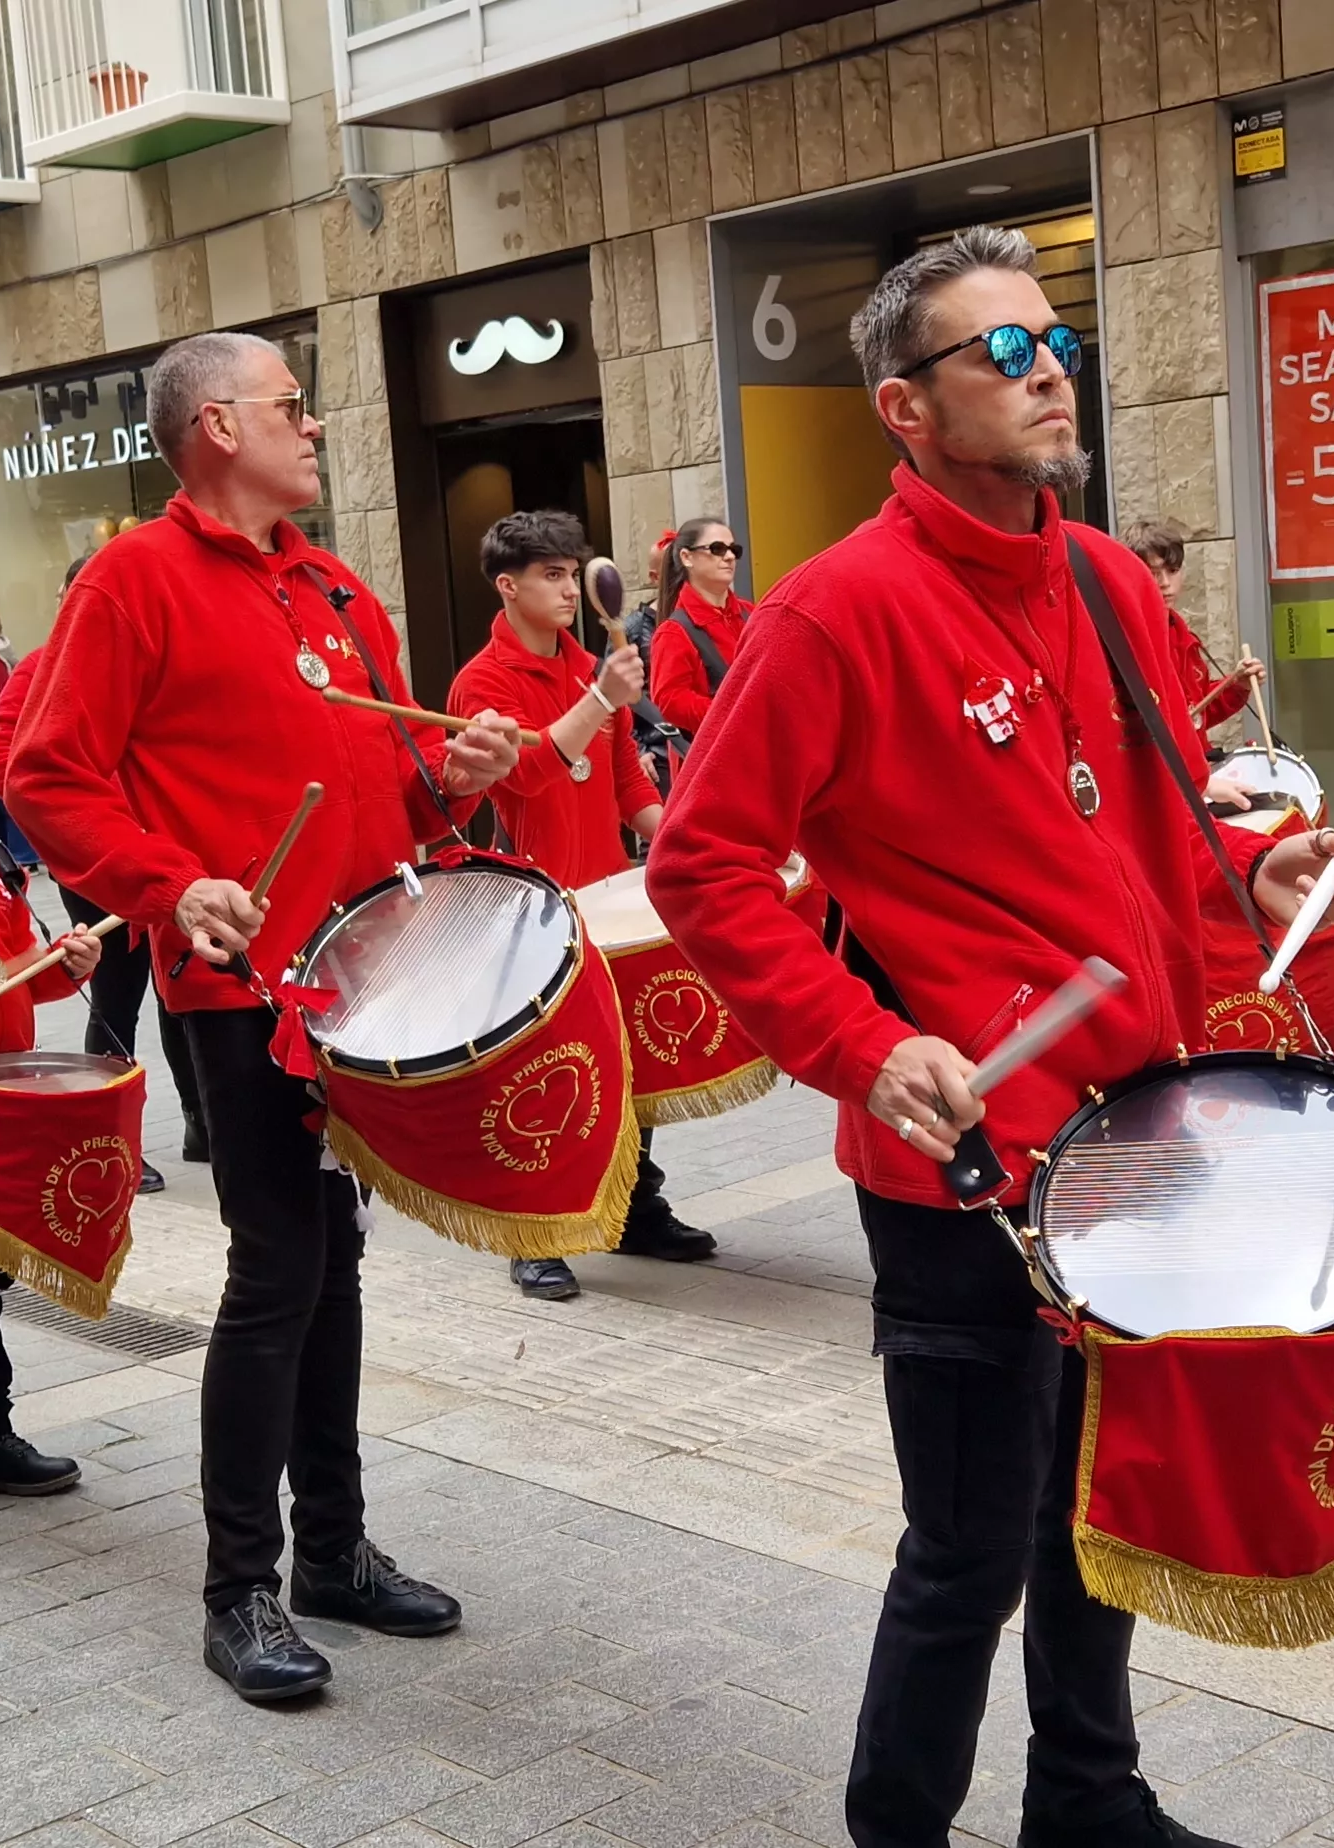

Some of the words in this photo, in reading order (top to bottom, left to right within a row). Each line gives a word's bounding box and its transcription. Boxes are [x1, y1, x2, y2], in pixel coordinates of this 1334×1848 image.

[752, 274, 797, 361] 6
[2, 424, 99, 481] NÚÑEZ
[634, 999, 645, 1016] DE
[638, 984, 654, 1000] LA
[1207, 991, 1293, 1026] PRECIOSISIMA
[633, 1019, 679, 1065] COFRADIA
[702, 1009, 728, 1057] SANGRE
[491, 1085, 515, 1106] LA
[577, 1067, 601, 1140] SANGRE
[480, 1108, 499, 1128] DE
[60, 1147, 81, 1166] LA
[480, 1132, 549, 1172] COFRADIA
[45, 1164, 64, 1186] DE
[40, 1189, 82, 1247] COFRADIA
